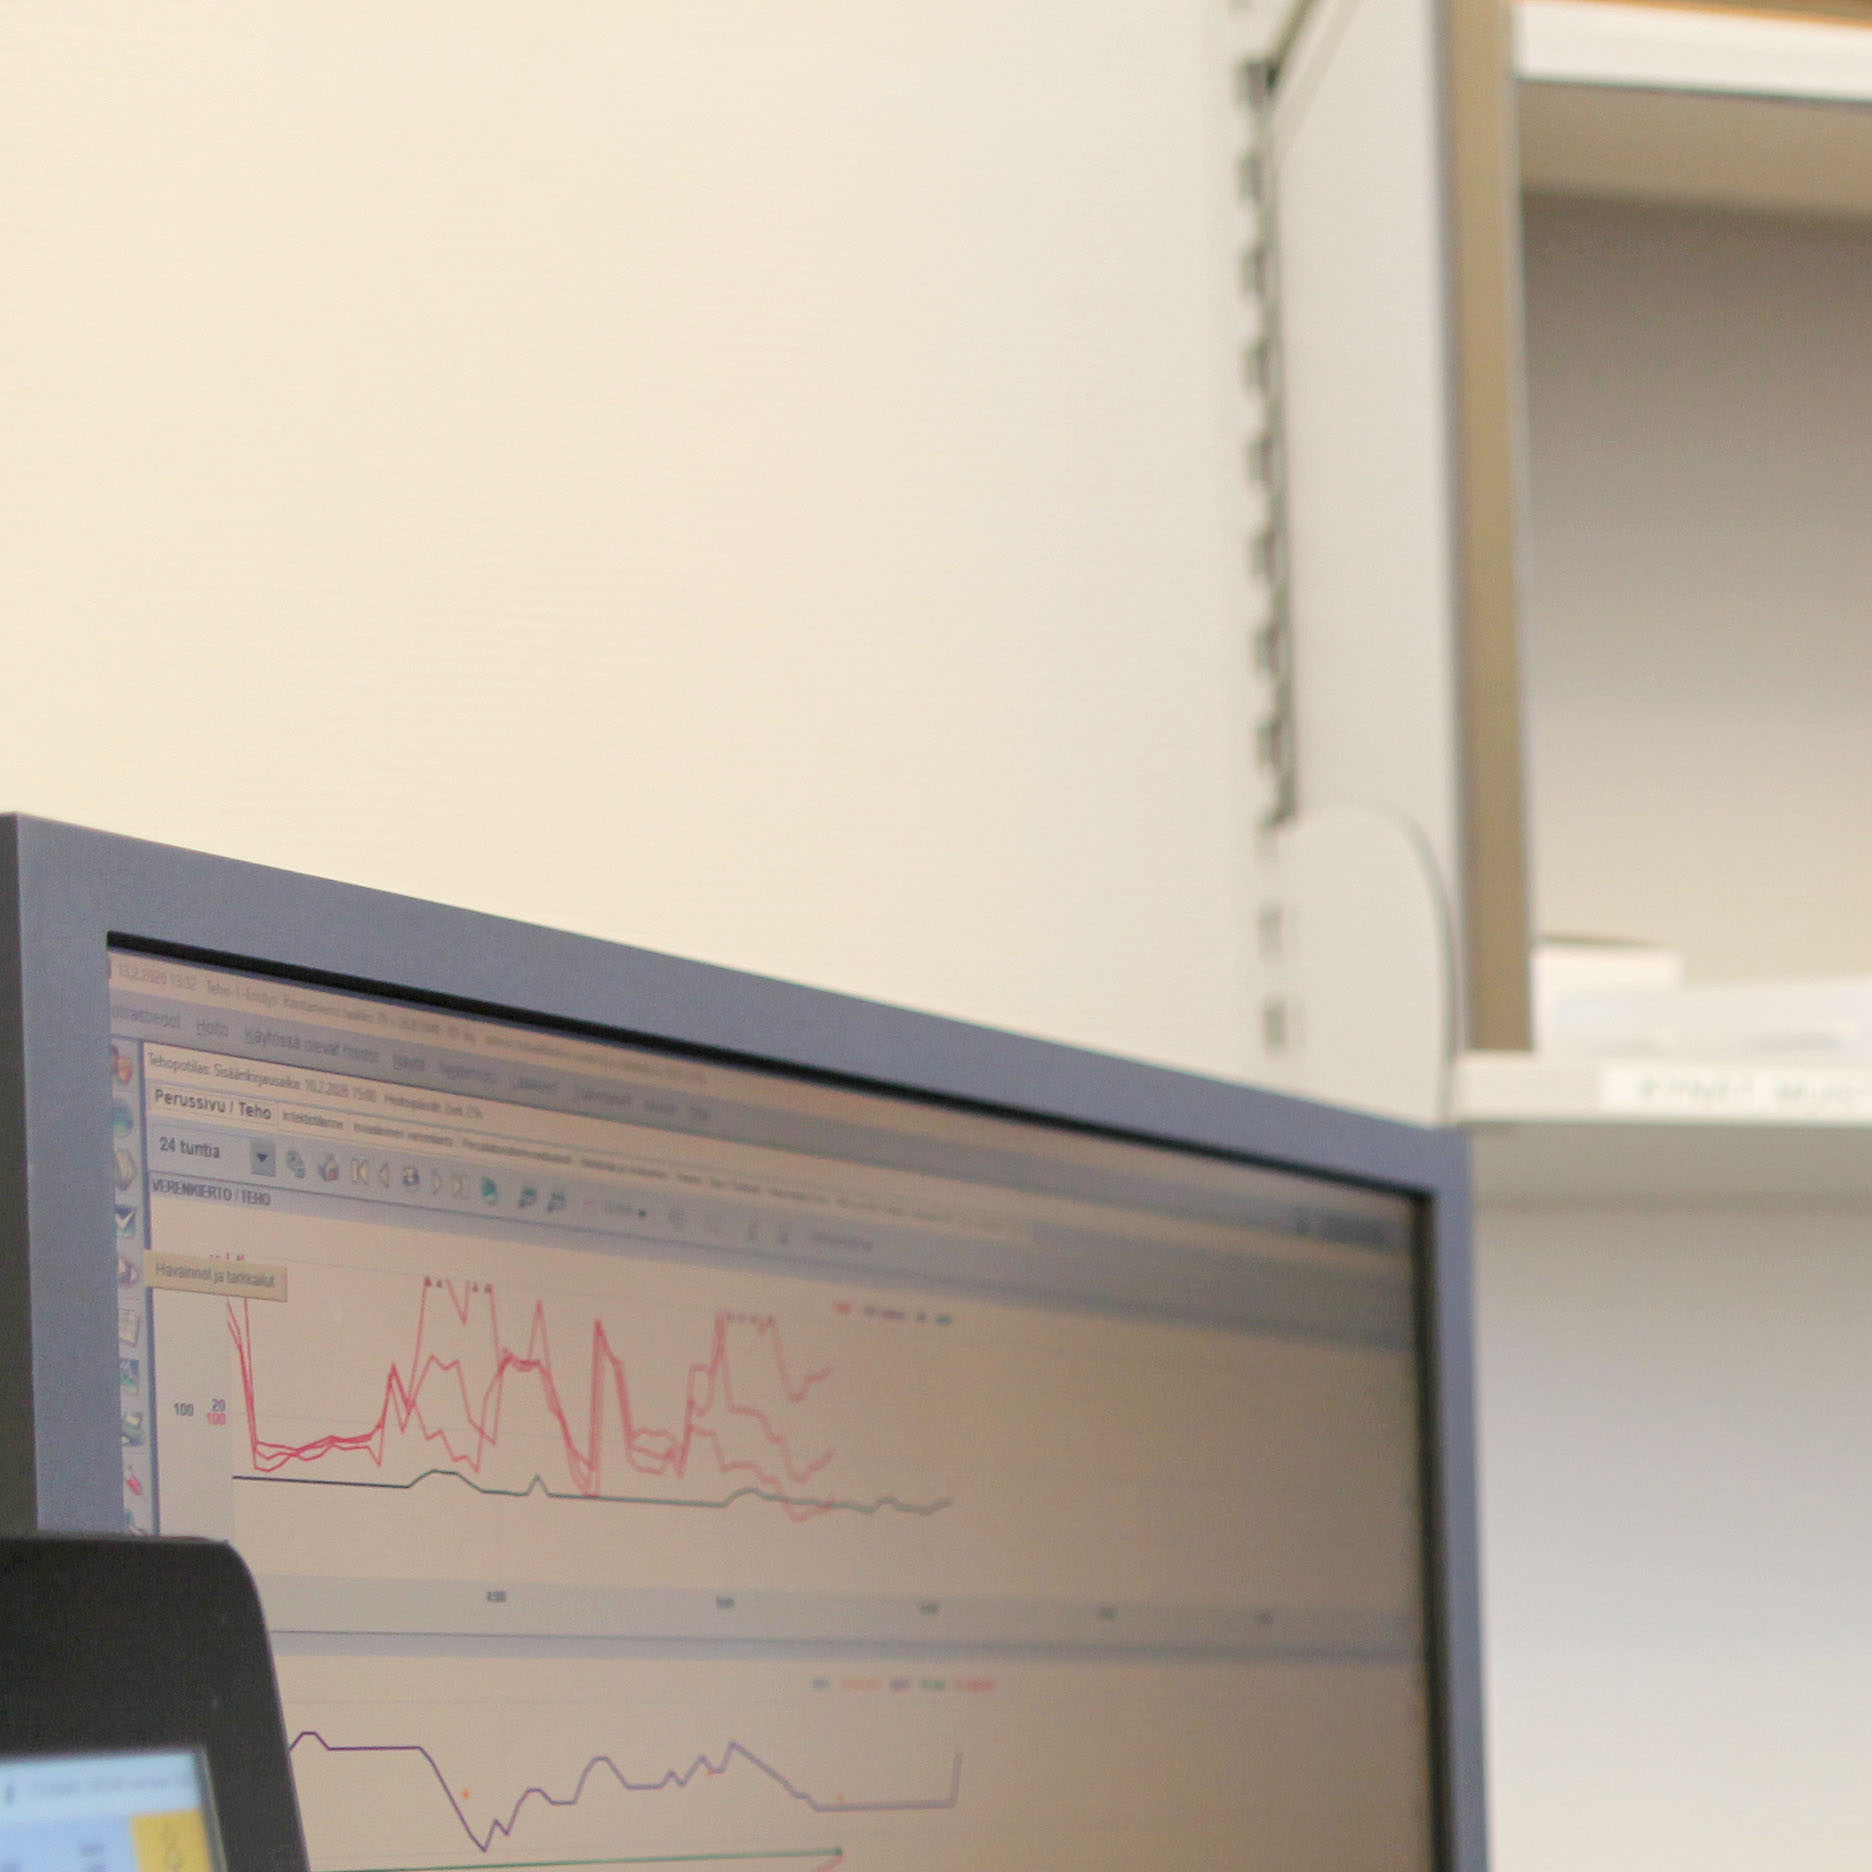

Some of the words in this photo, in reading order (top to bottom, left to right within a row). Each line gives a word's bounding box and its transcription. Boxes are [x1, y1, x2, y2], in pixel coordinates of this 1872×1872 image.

[154, 1088, 227, 1113] Perussivu
[239, 1100, 273, 1121] Teho
[159, 1136, 177, 1153] 24
[179, 1139, 221, 1159] tuntia
[173, 1402, 194, 1417] 100
